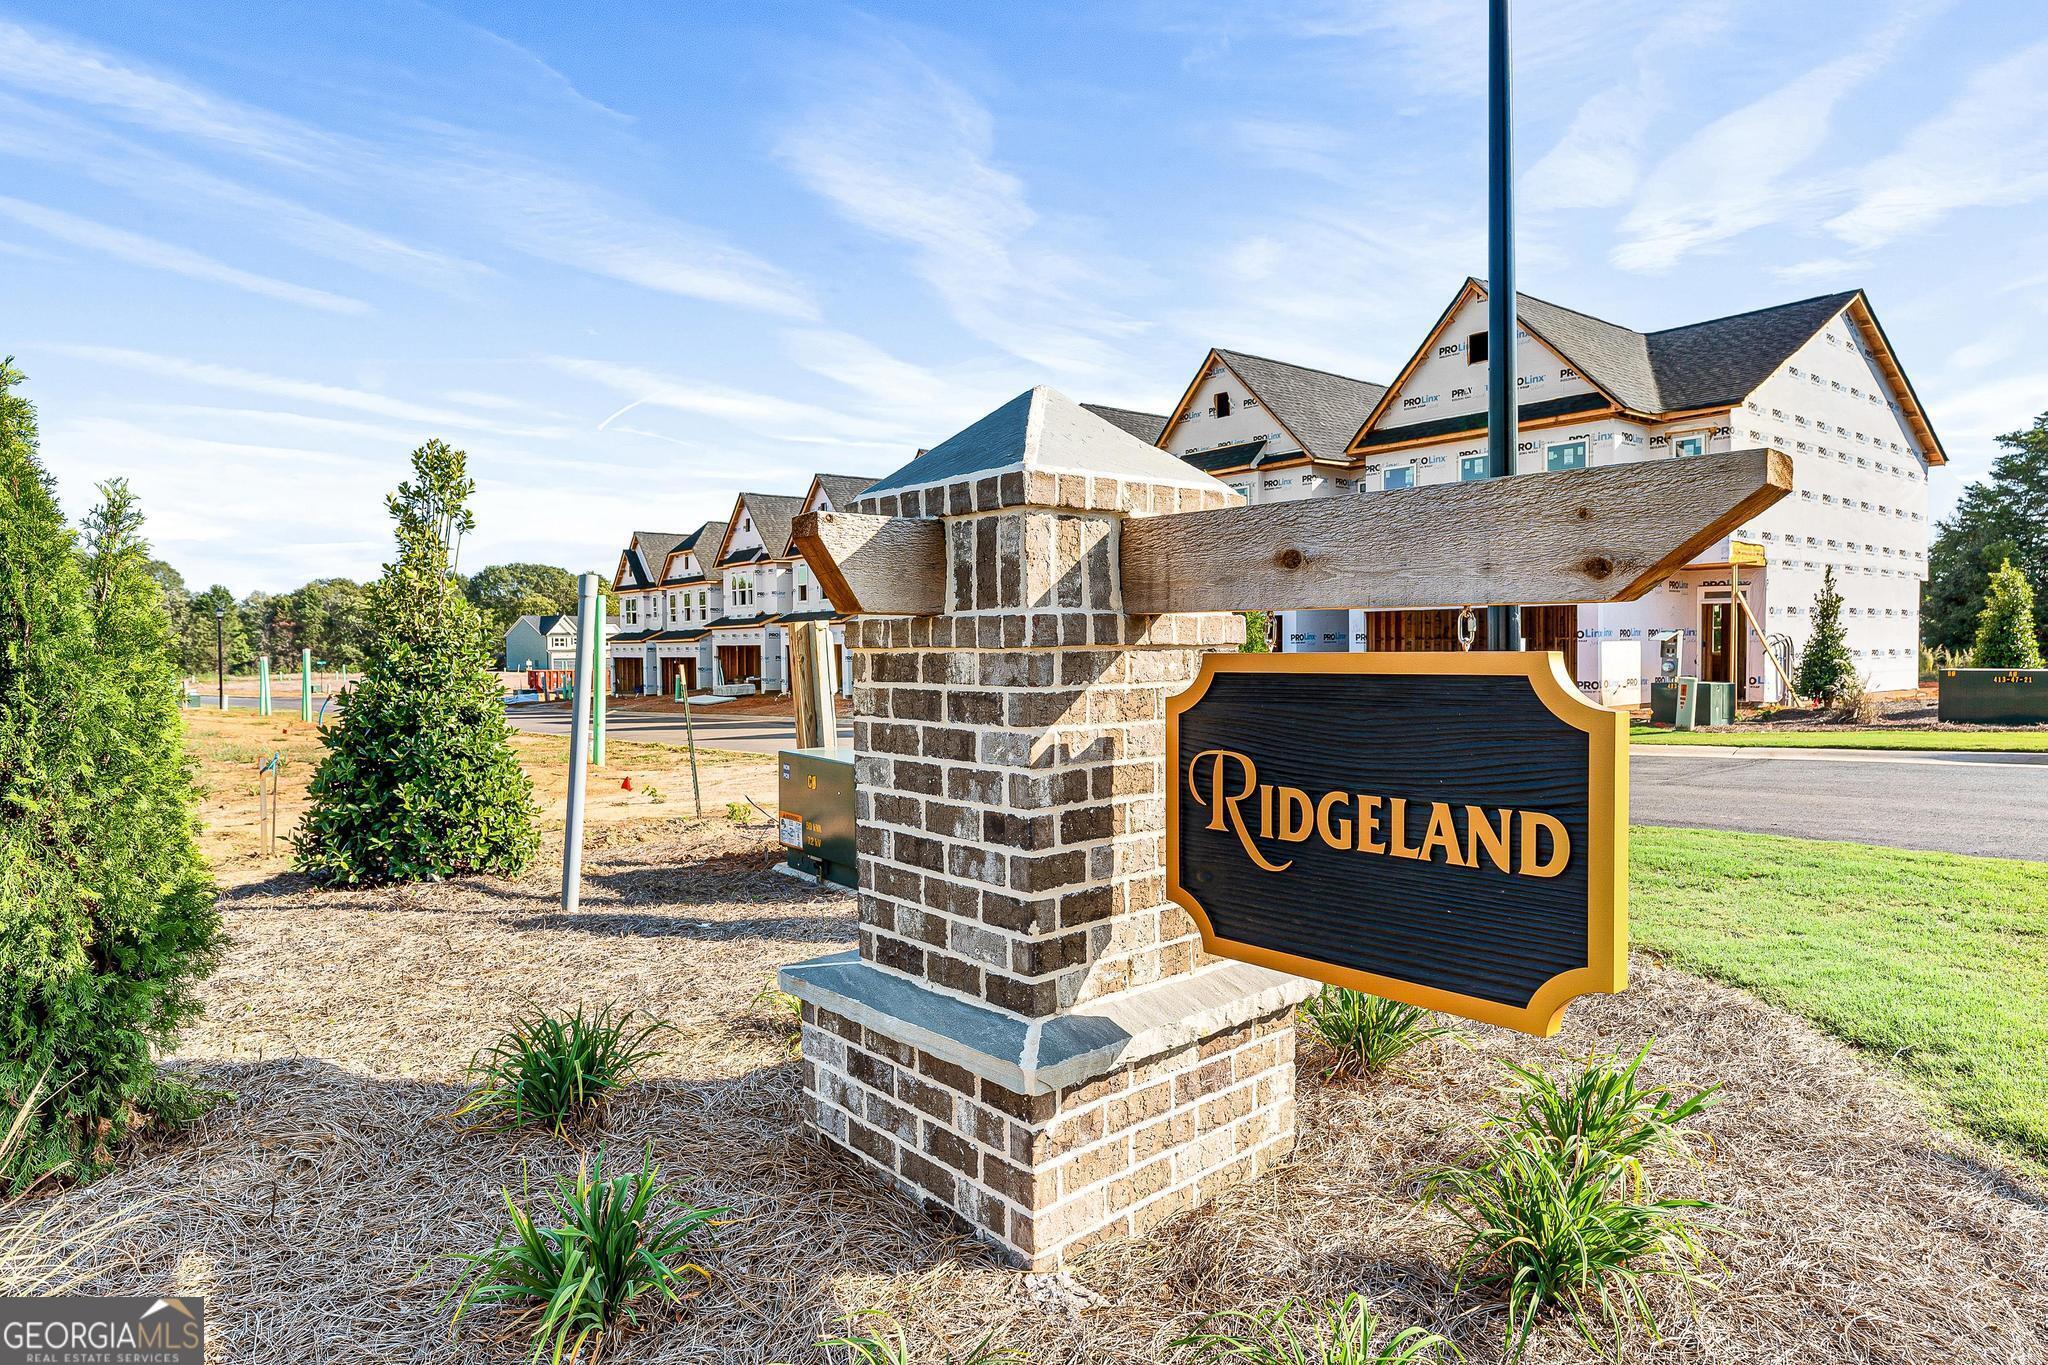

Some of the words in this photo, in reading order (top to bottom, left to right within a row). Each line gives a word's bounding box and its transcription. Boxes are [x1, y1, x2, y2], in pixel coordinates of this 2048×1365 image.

[1439, 341, 1465, 355] PROLi
[1517, 374, 1544, 386] OLinx
[1404, 395, 1438, 407] PROLinx
[1518, 440, 1541, 451] ROLi
[1264, 478, 1293, 487] PROLinx
